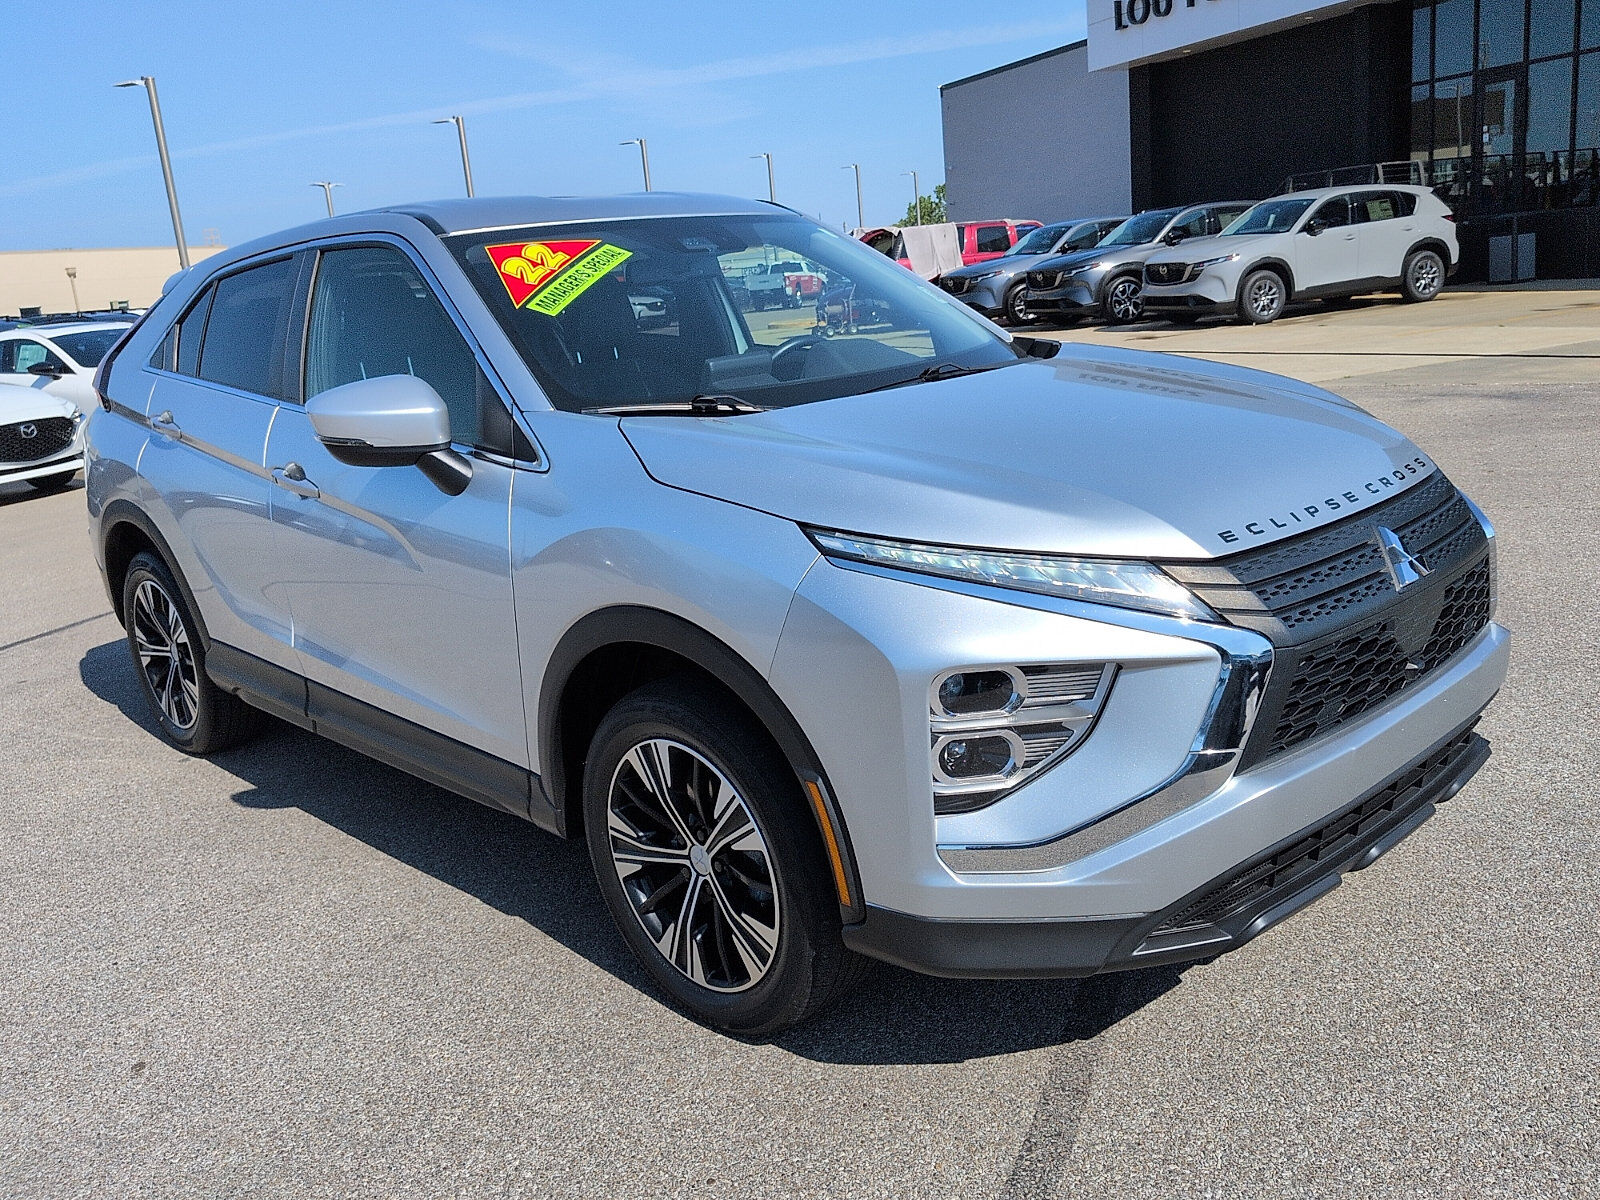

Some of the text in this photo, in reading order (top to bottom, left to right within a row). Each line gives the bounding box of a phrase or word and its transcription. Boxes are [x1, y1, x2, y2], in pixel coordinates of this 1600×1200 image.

[501, 243, 571, 285] 22
[535, 248, 623, 311] MANAGER'S SPECIAL
[1218, 457, 1427, 543] ECLIPSE CROSS
